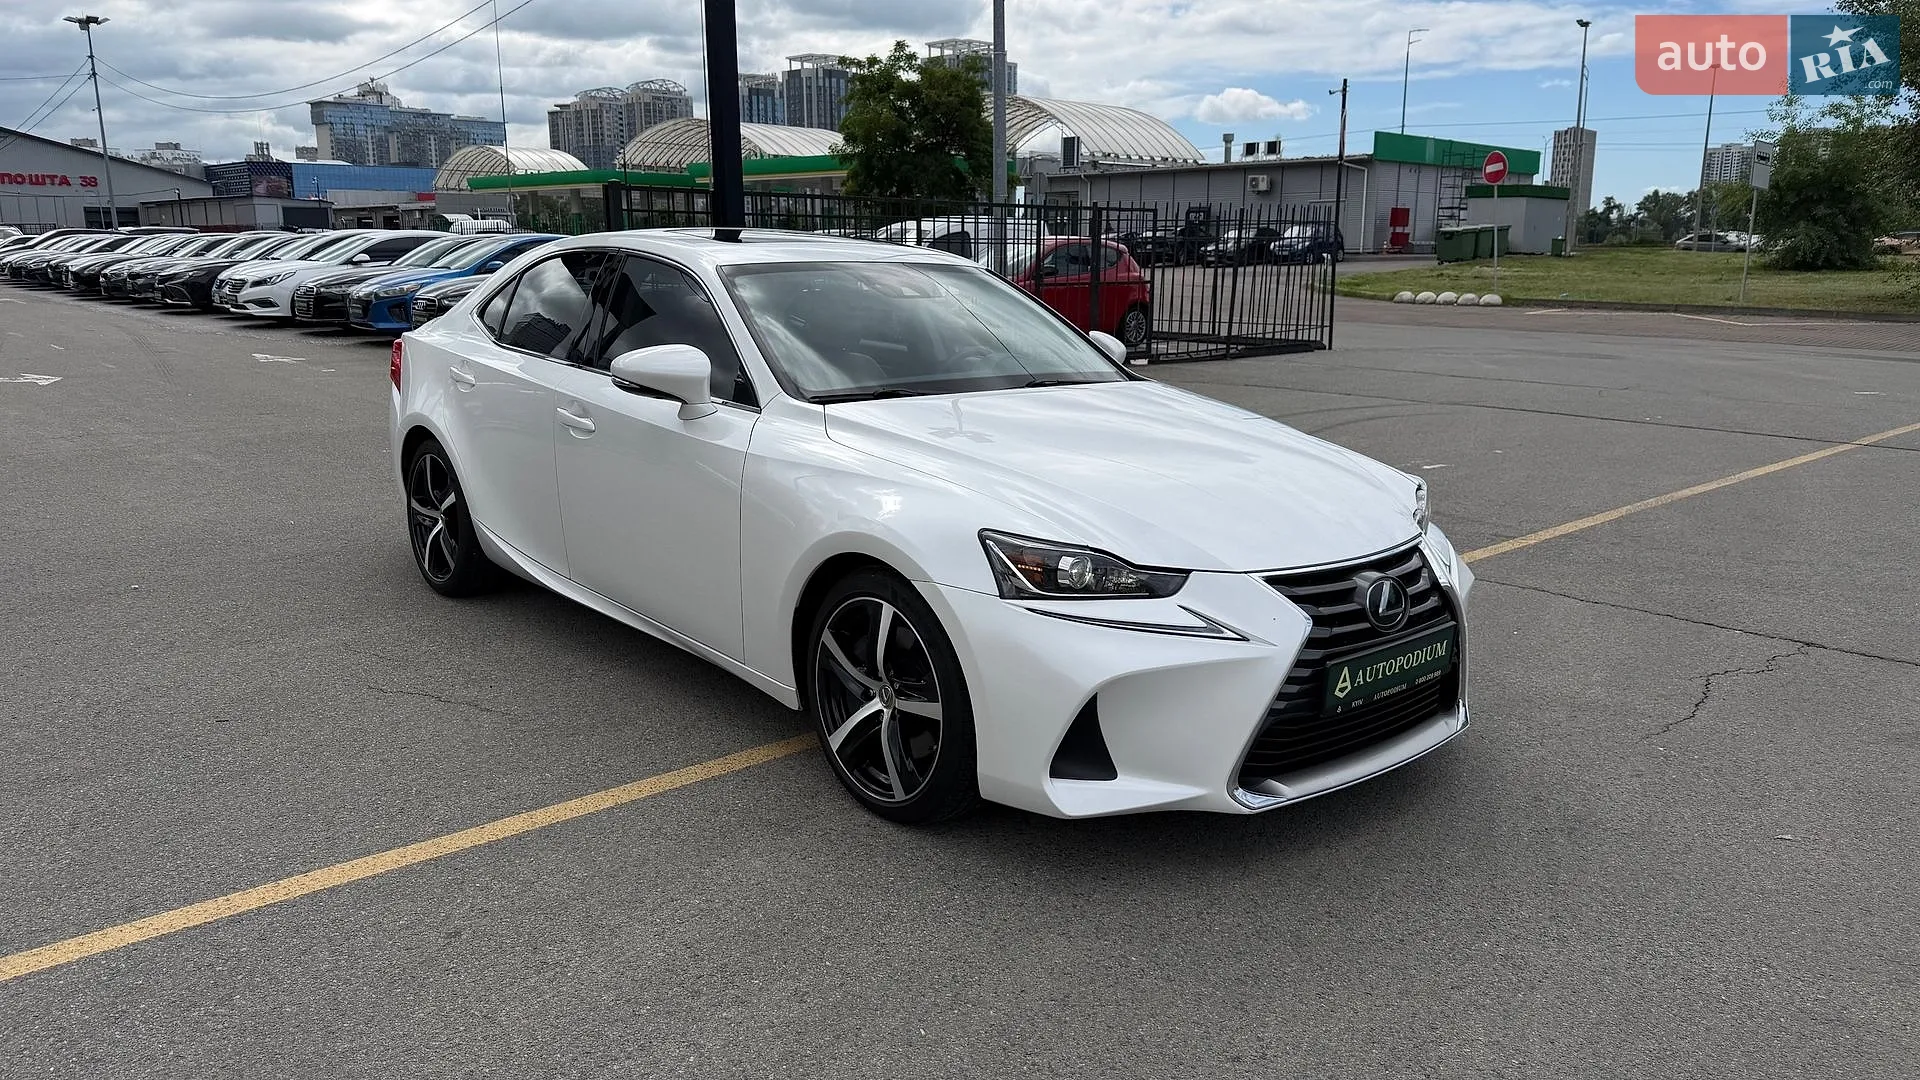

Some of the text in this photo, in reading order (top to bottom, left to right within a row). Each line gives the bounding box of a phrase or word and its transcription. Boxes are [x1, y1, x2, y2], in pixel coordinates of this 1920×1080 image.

[0, 172, 98, 187] ПОШТА 38
[1354, 640, 1448, 687] AUTOPODIUM
